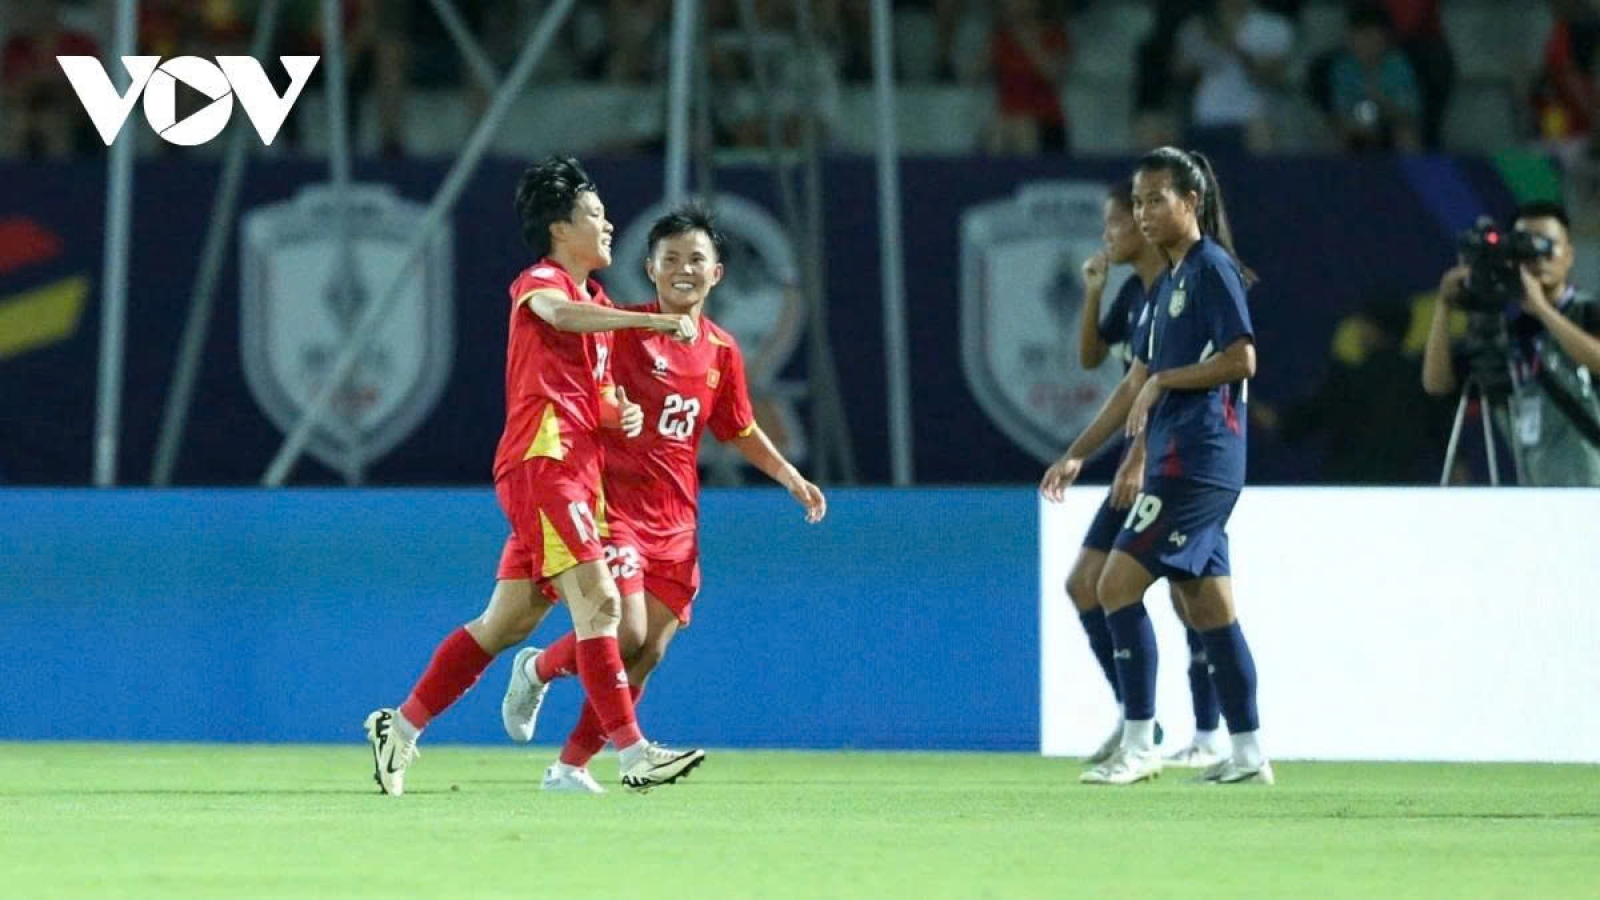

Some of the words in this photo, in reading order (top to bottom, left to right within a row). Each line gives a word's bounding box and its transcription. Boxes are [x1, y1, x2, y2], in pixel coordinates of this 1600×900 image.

[658, 393, 701, 439] 23
[1124, 491, 1162, 533] 19
[603, 544, 640, 579] 23
